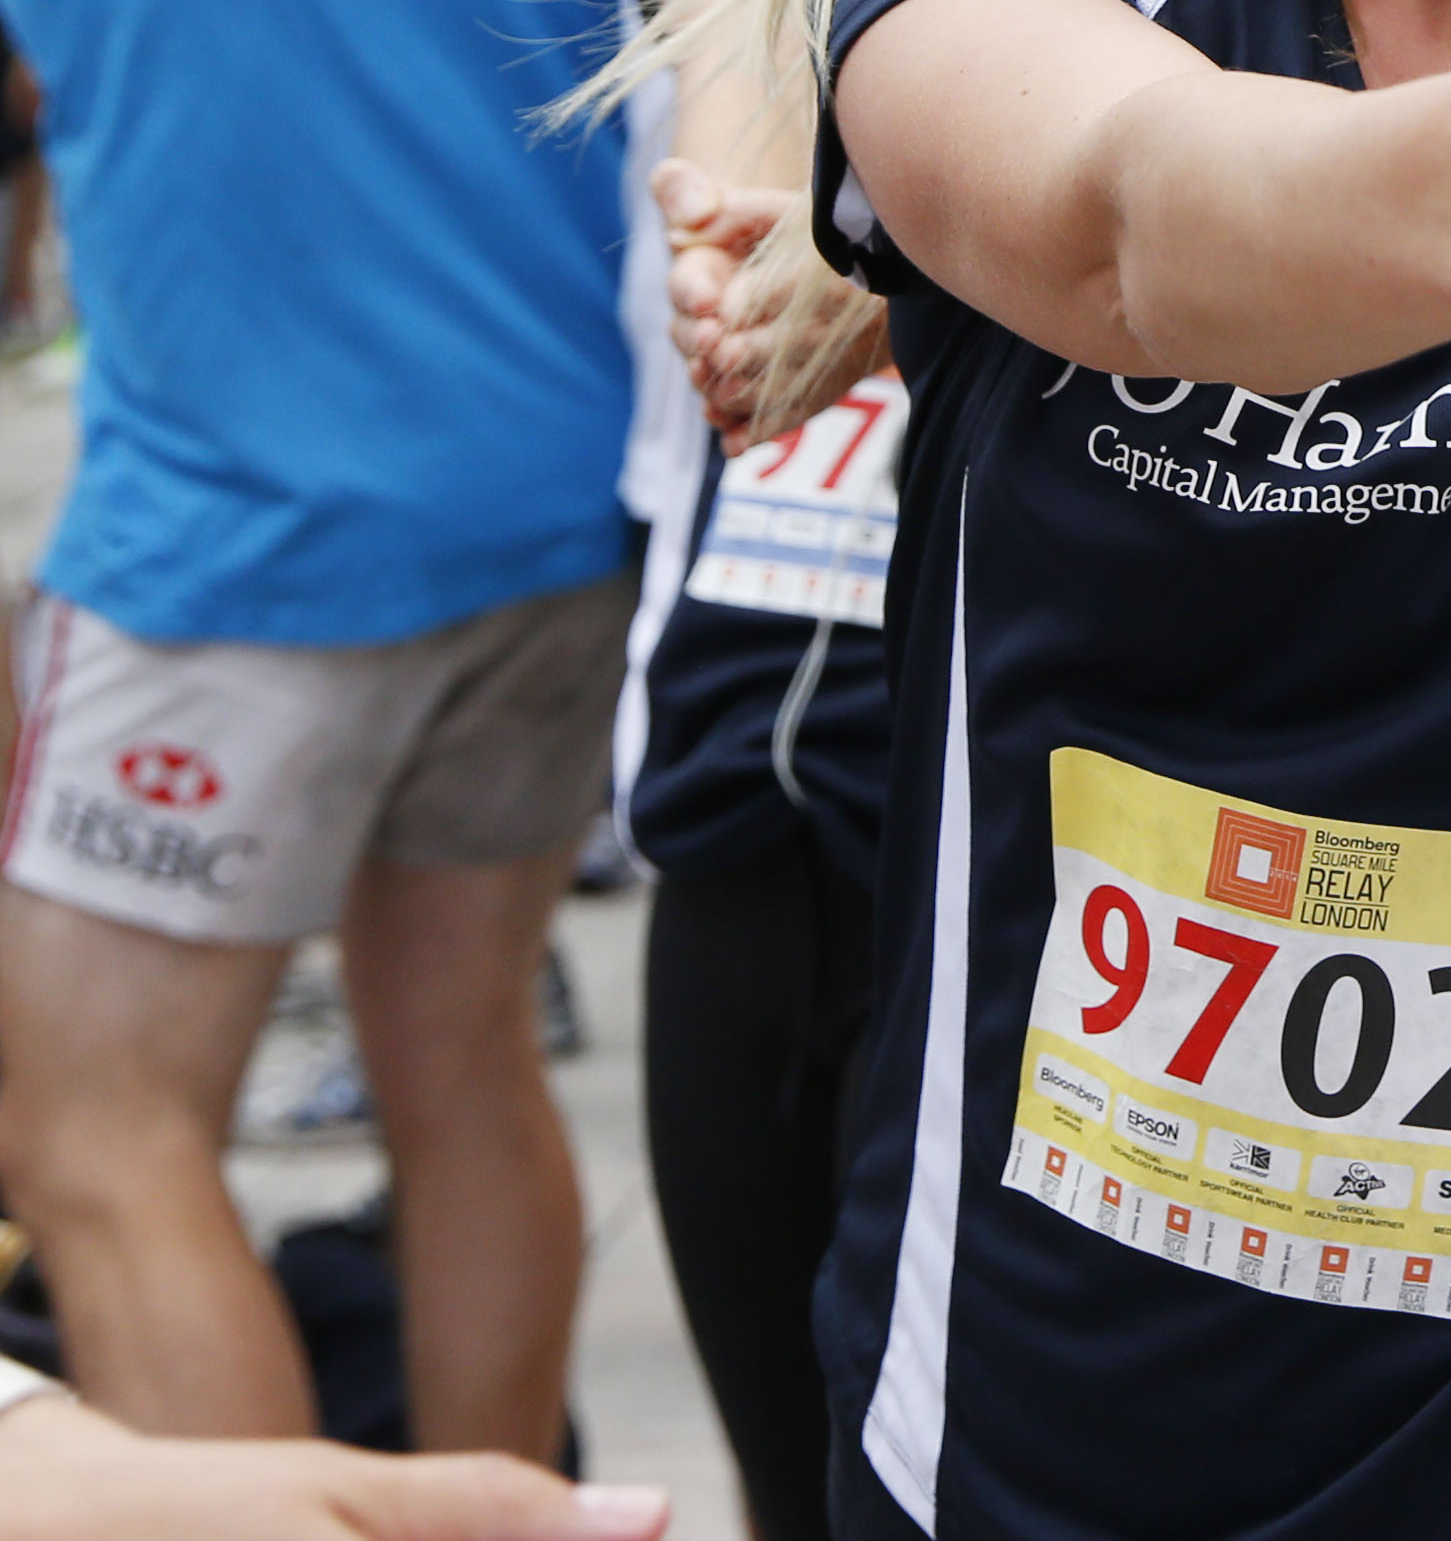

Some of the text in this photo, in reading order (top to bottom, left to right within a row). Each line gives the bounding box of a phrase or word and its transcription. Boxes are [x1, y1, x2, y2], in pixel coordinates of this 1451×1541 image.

[1087, 424, 1212, 504] Capital
[1314, 830, 1400, 855] Bloomberg
[1311, 850, 1399, 873] SQUARE MILE
[1306, 867, 1394, 903] RELAY
[1300, 901, 1389, 932] LONDON
[1040, 1067, 1104, 1112] Bloomberg
[1127, 1109, 1180, 1141] EPSON
